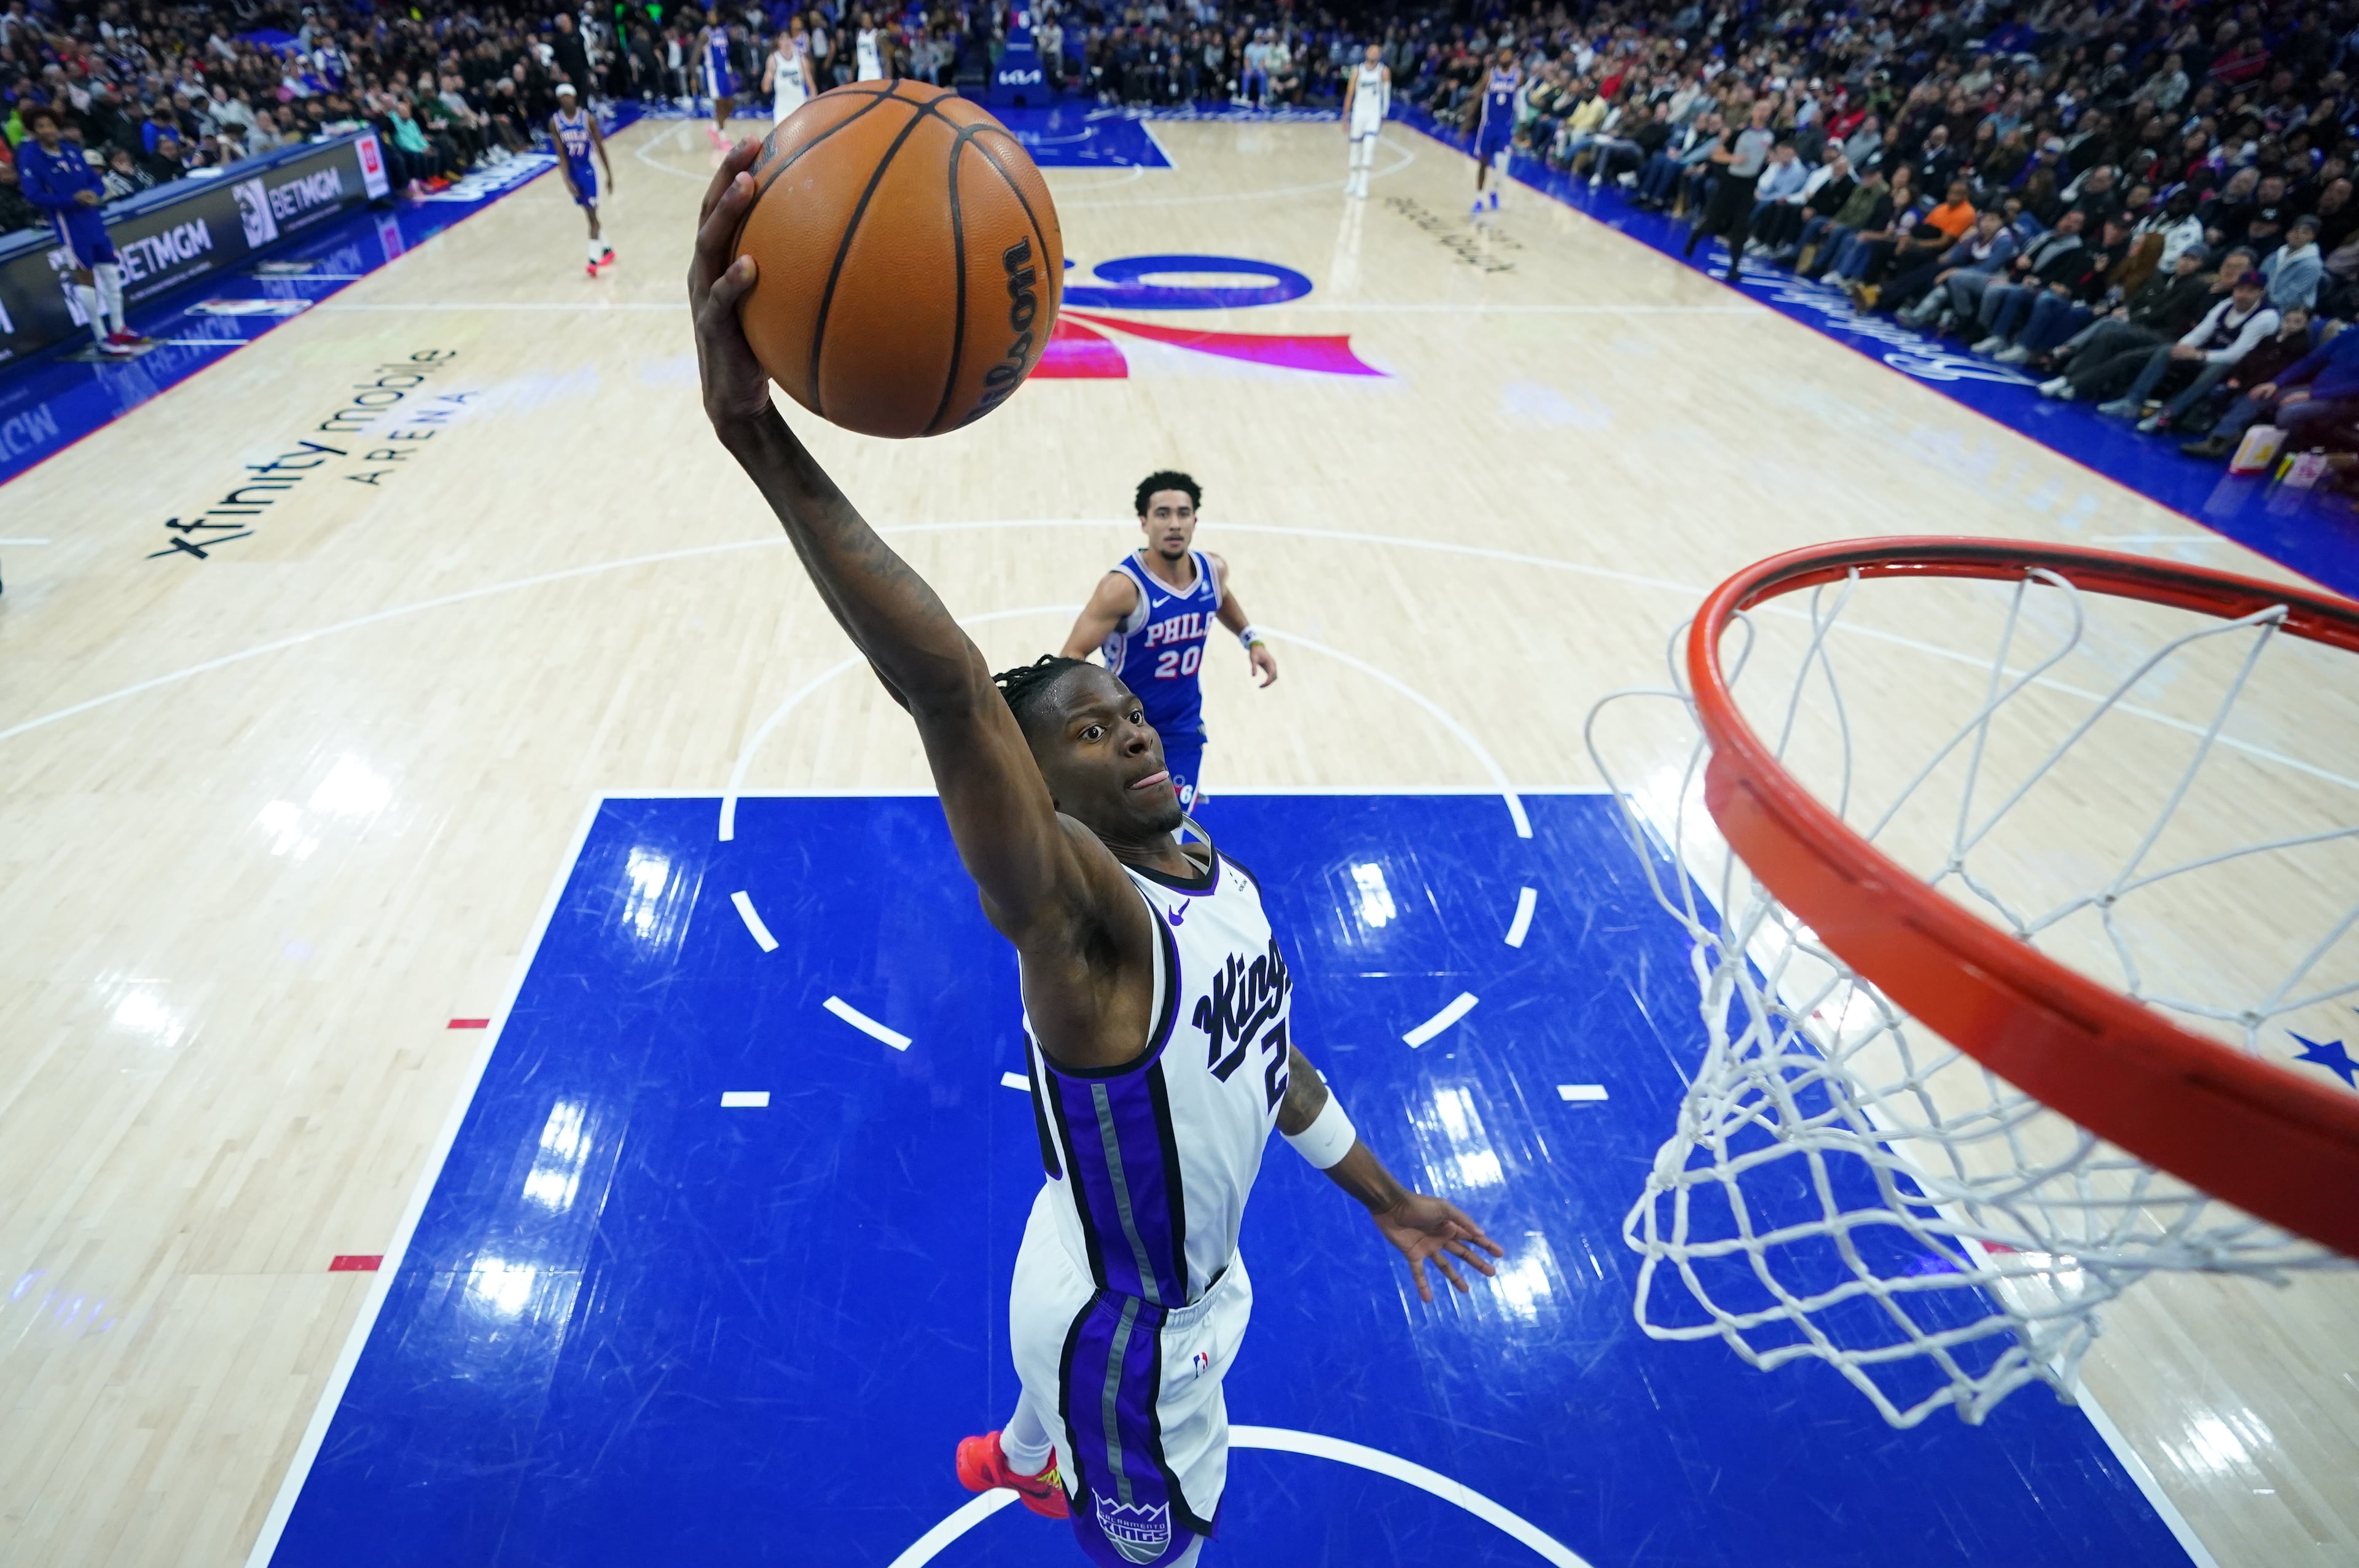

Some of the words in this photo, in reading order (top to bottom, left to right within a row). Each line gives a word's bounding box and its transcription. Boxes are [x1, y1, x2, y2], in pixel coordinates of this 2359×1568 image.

[268, 166, 343, 220] BETMGM
[314, 349, 458, 432] mobile
[345, 390, 480, 486] ARENA
[1154, 646, 1202, 678] 20
[1261, 1016, 1289, 1117] 2
[1100, 1510, 1165, 1531] SACRAMENTO
[1103, 1519, 1168, 1543] KINGS
